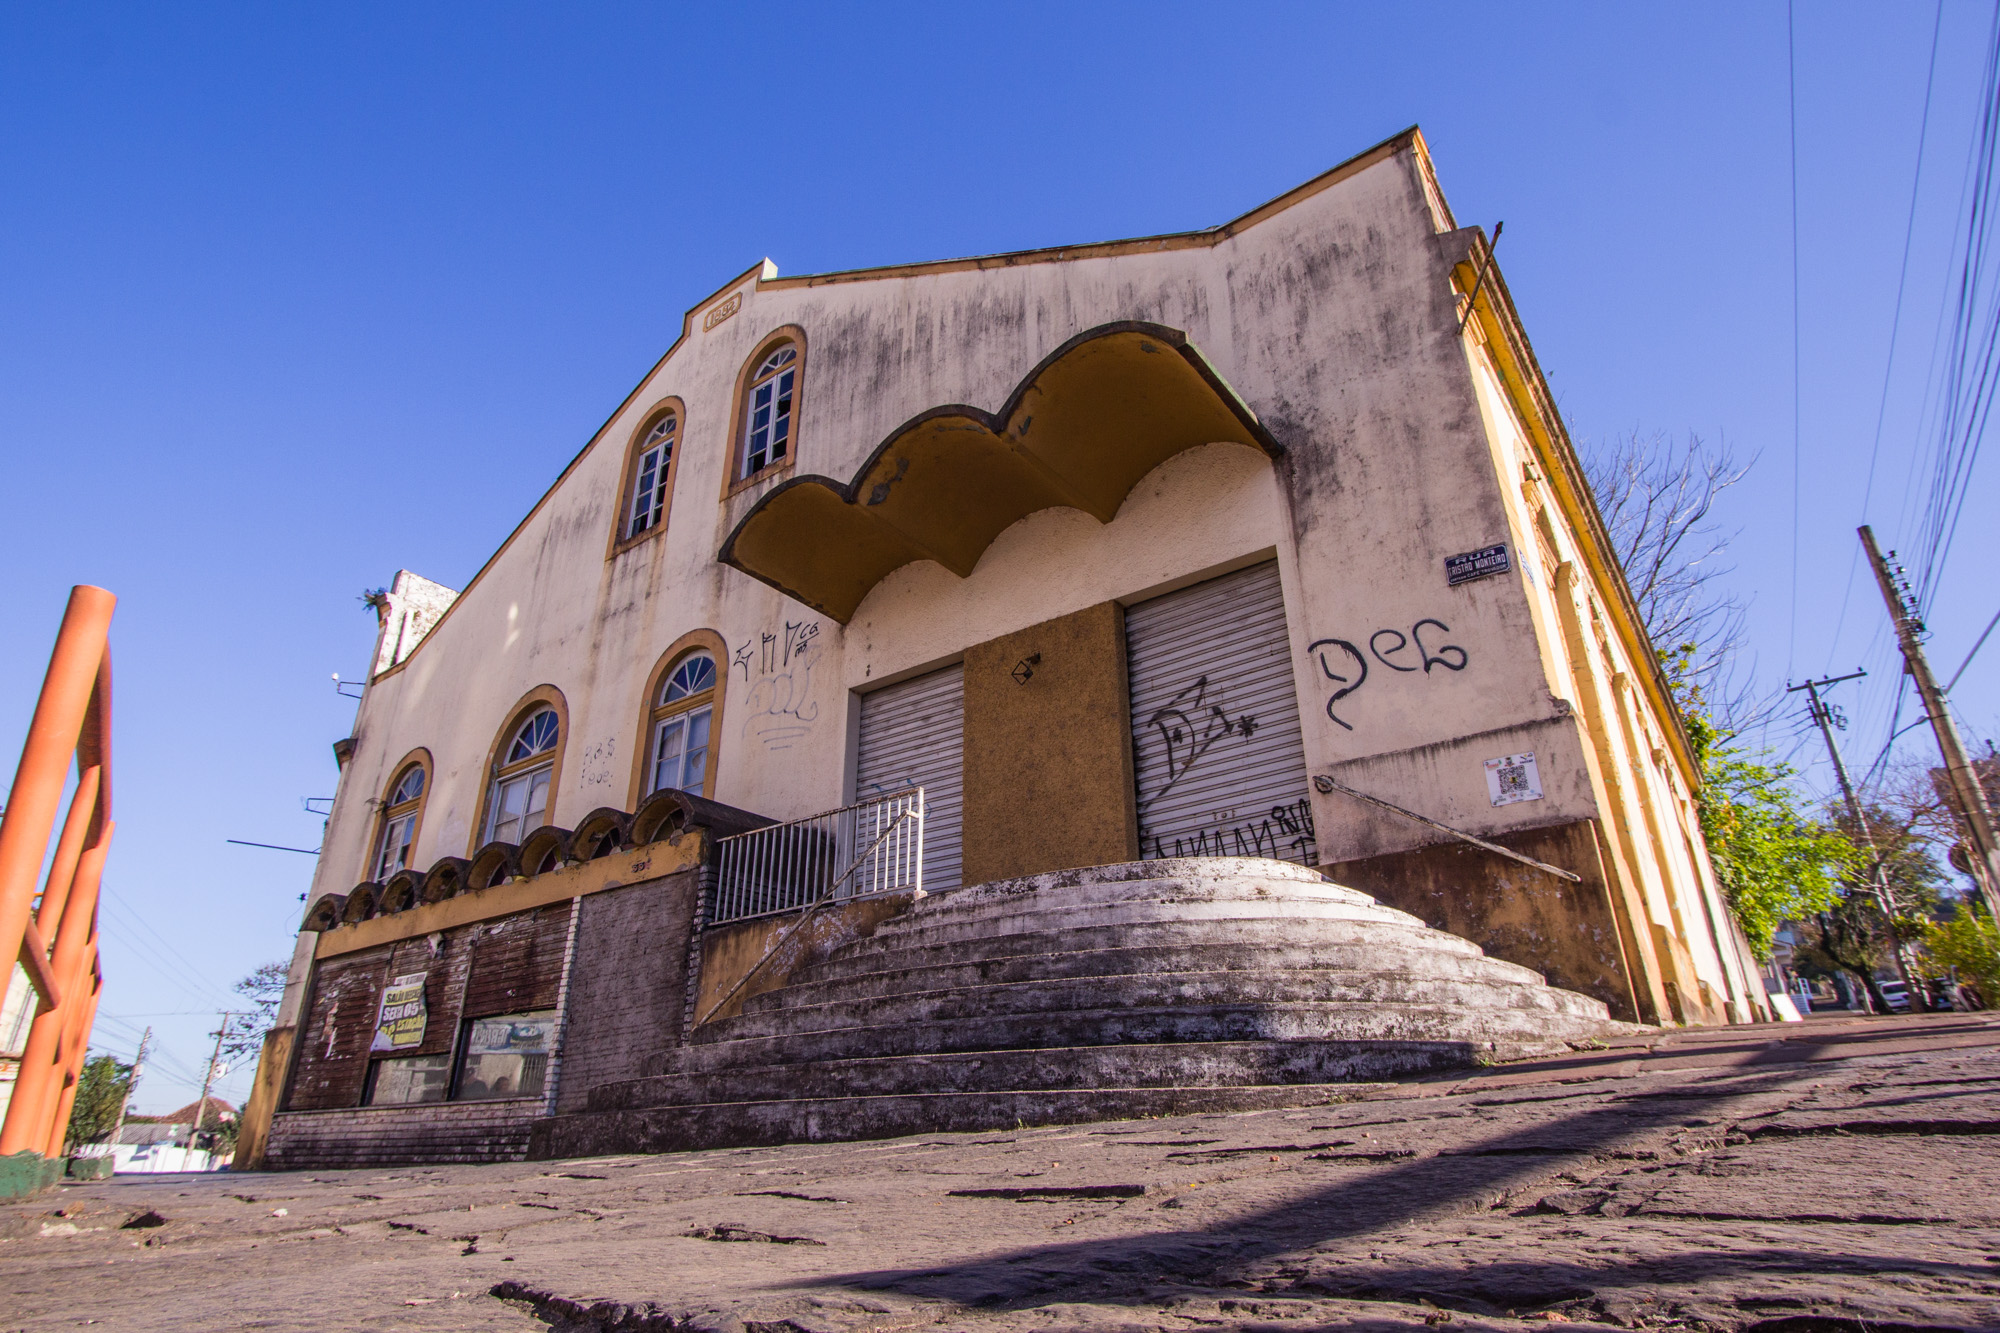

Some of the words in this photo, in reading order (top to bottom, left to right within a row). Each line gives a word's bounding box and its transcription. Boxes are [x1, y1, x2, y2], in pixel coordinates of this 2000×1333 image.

[1455, 549, 1496, 564] RUA
[1474, 553, 1507, 569] MONTEIRO
[404, 1002, 419, 1017] 05
